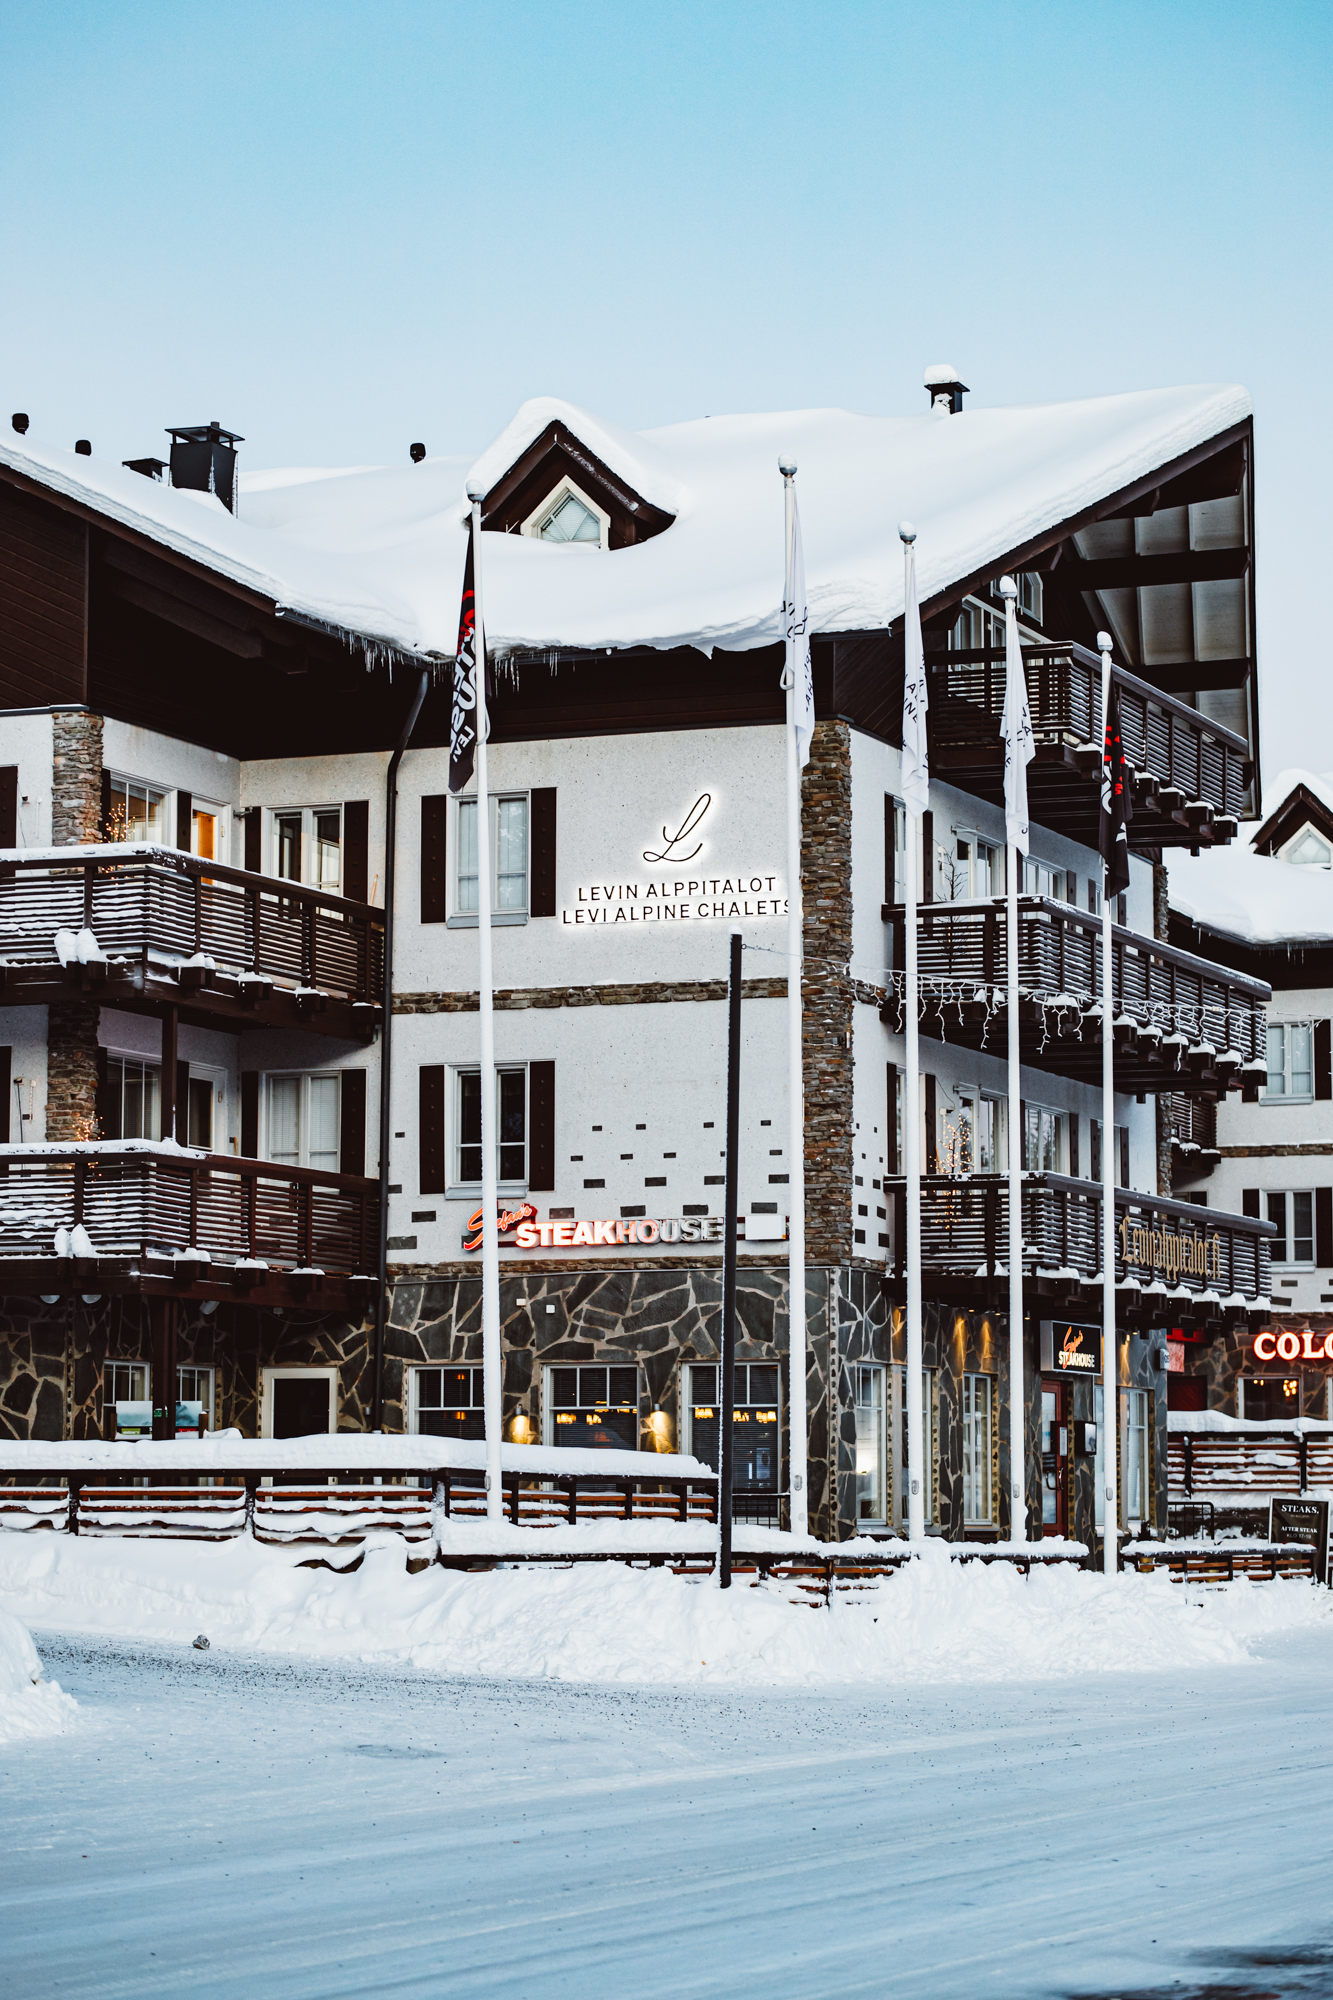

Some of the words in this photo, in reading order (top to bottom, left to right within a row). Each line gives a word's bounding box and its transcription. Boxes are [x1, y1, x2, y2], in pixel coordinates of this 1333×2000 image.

[578, 884, 638, 901] LEVIN
[646, 877, 776, 898] ALPPITALOT
[562, 909, 607, 924] LEVI
[615, 904, 690, 922] ALPINE
[463, 1203, 532, 1250] Sefan's
[515, 1217, 724, 1248] STEAKHOUSE
[1281, 1504, 1320, 1514] STEAKS.
